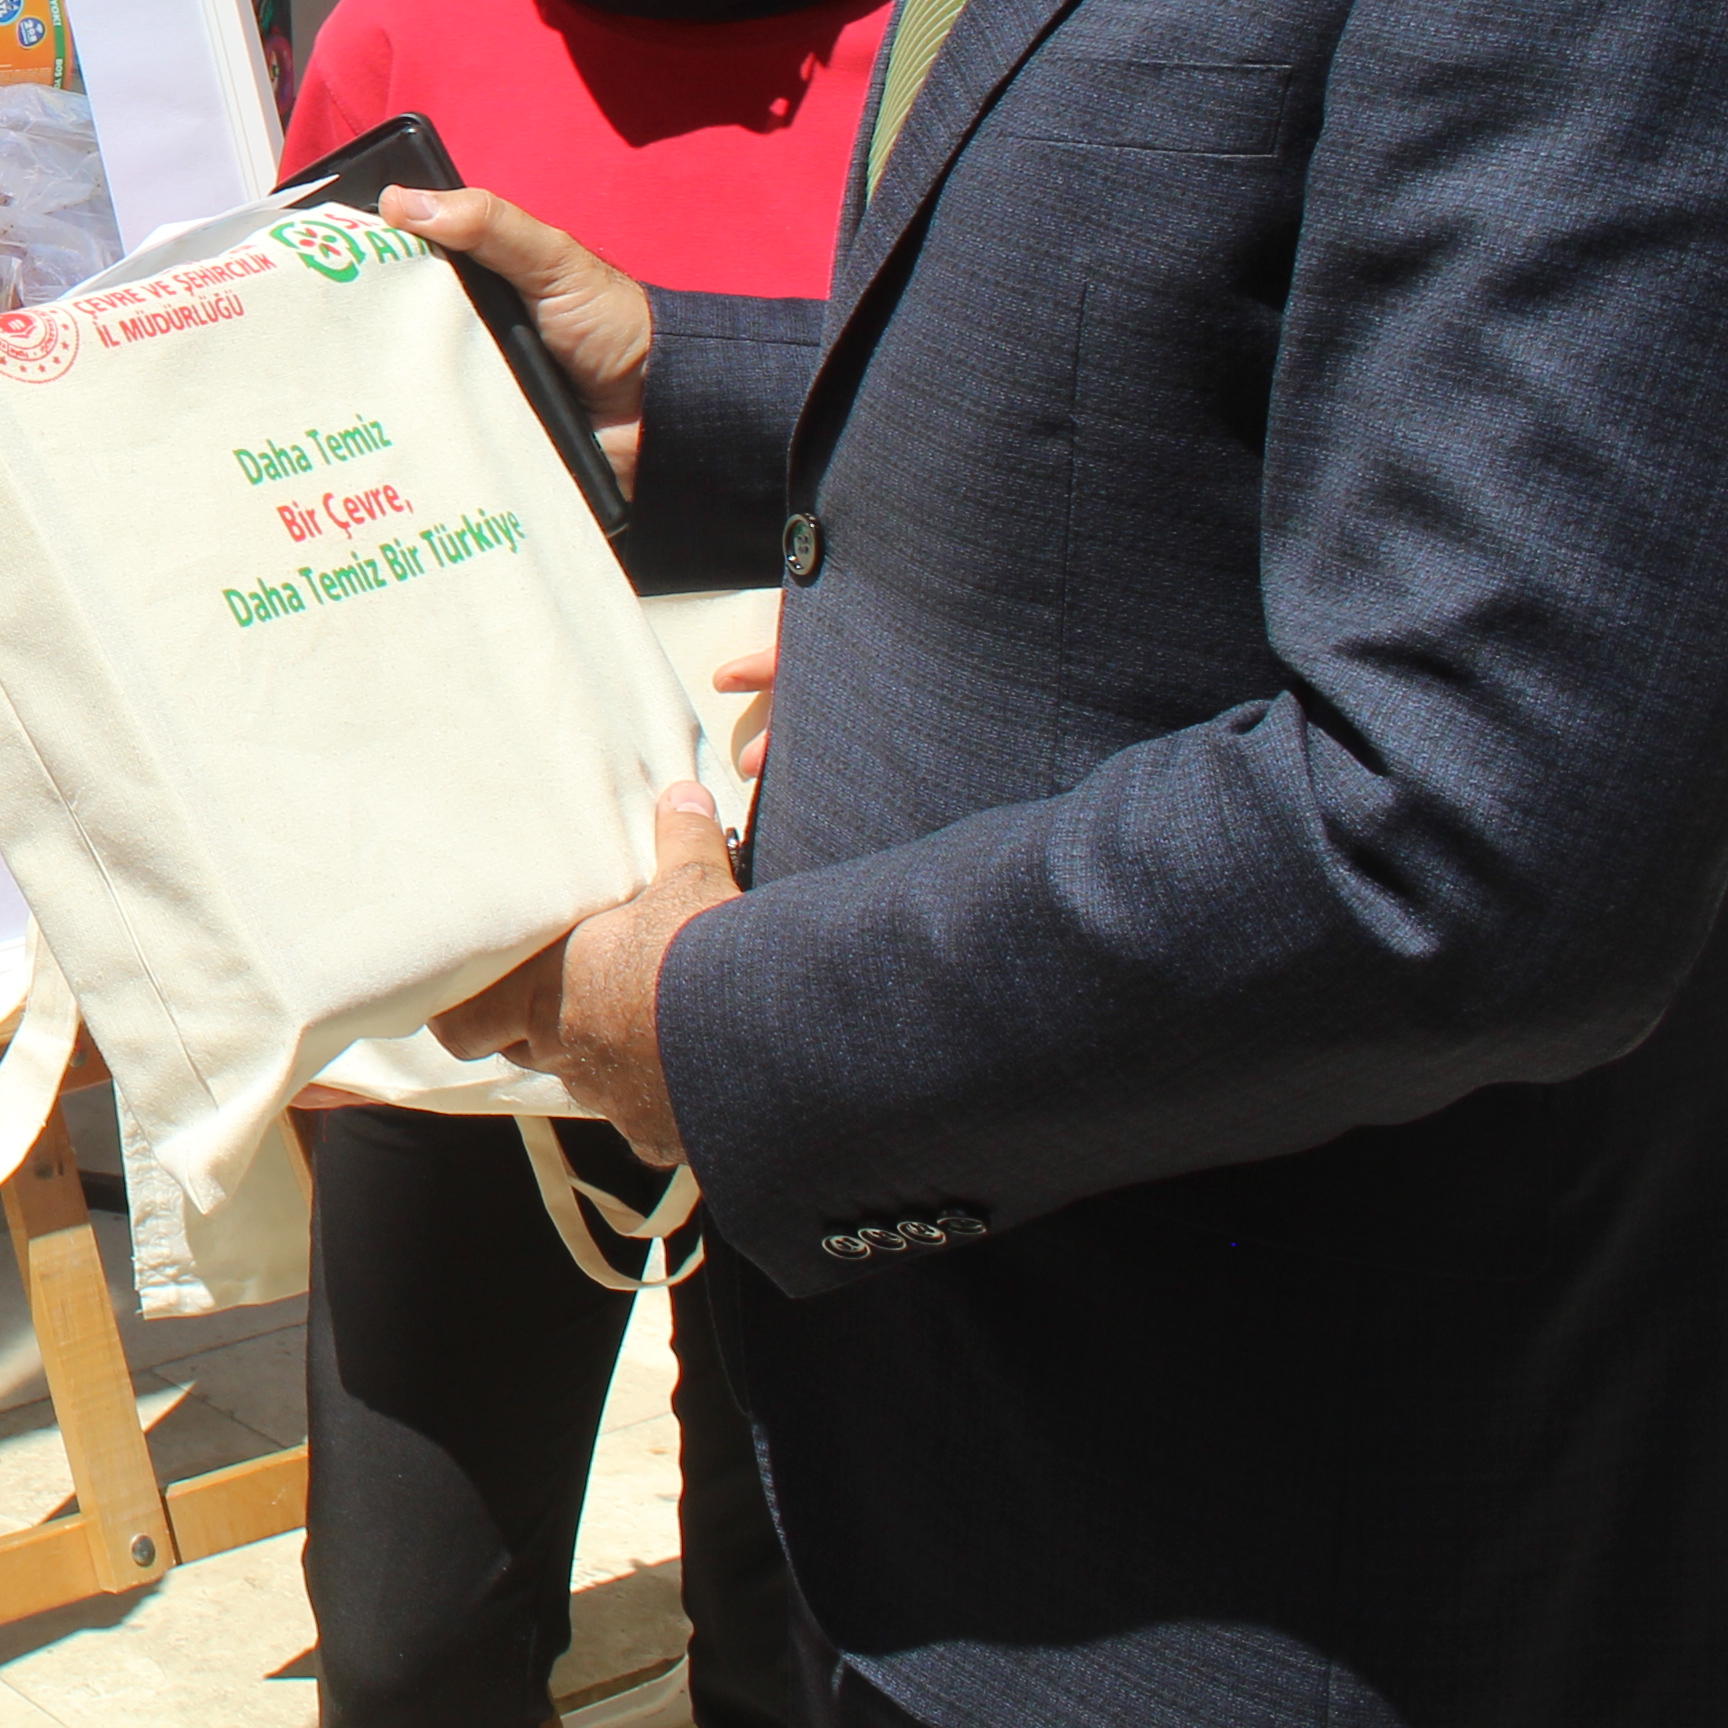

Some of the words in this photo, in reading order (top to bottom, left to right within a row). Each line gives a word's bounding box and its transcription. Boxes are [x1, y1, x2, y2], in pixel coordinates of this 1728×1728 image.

[72, 284, 152, 320] ÇEVRE
[147, 278, 176, 301] VE
[175, 249, 277, 298] ŞEHİRCİLİK
[92, 314, 120, 349] İL
[121, 289, 245, 344] MÜDÜRLÜĞÜ
[232, 438, 313, 485] Daha
[304, 413, 392, 465] Temiz
[276, 500, 323, 542] Bir
[322, 484, 414, 540] Çevre,
[222, 577, 305, 627] Daha
[297, 550, 387, 605] Temiz
[378, 537, 425, 581] Bir
[419, 508, 527, 568] Türkiye
